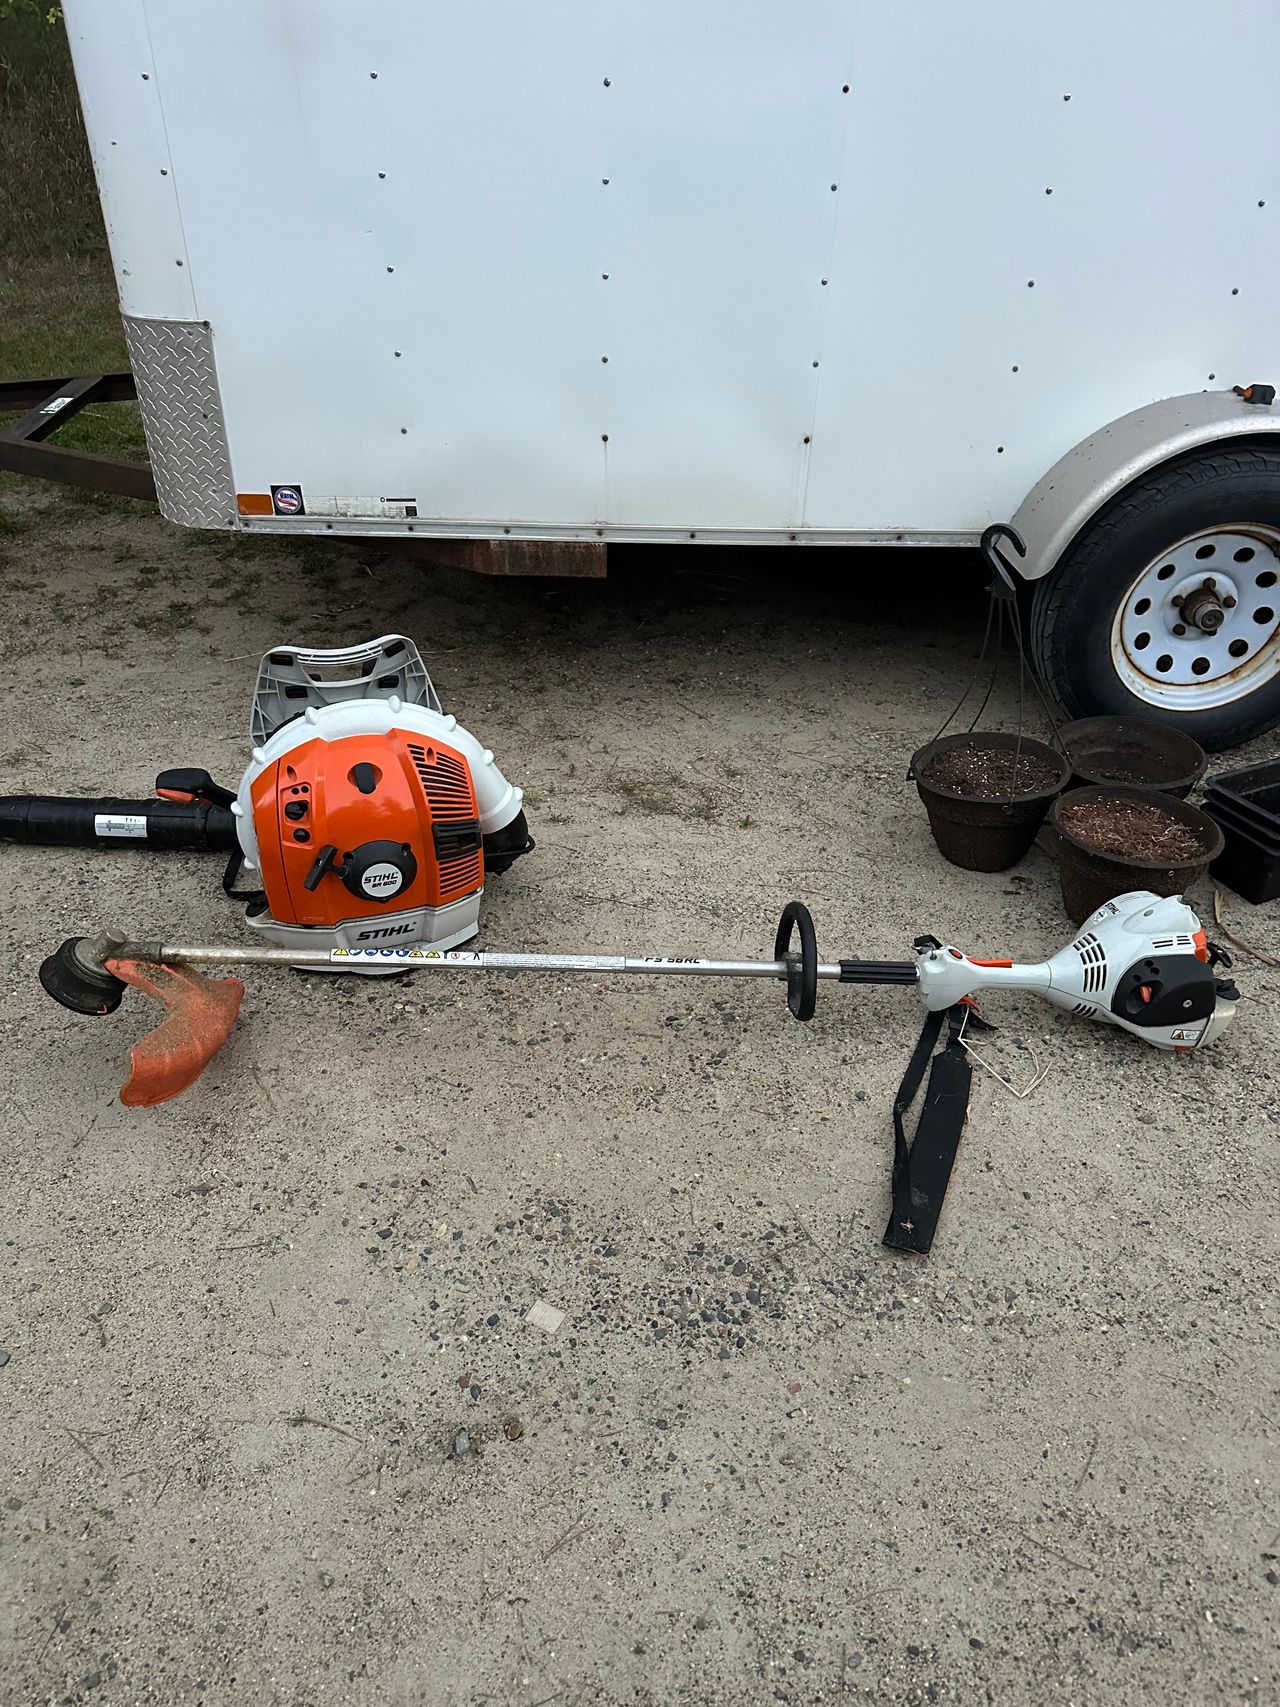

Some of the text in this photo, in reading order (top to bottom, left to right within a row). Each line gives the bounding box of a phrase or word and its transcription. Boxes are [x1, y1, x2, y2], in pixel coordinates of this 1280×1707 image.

[363, 872, 398, 884] STIHL
[1105, 902, 1120, 915] STIHL
[356, 924, 415, 941] STIHL
